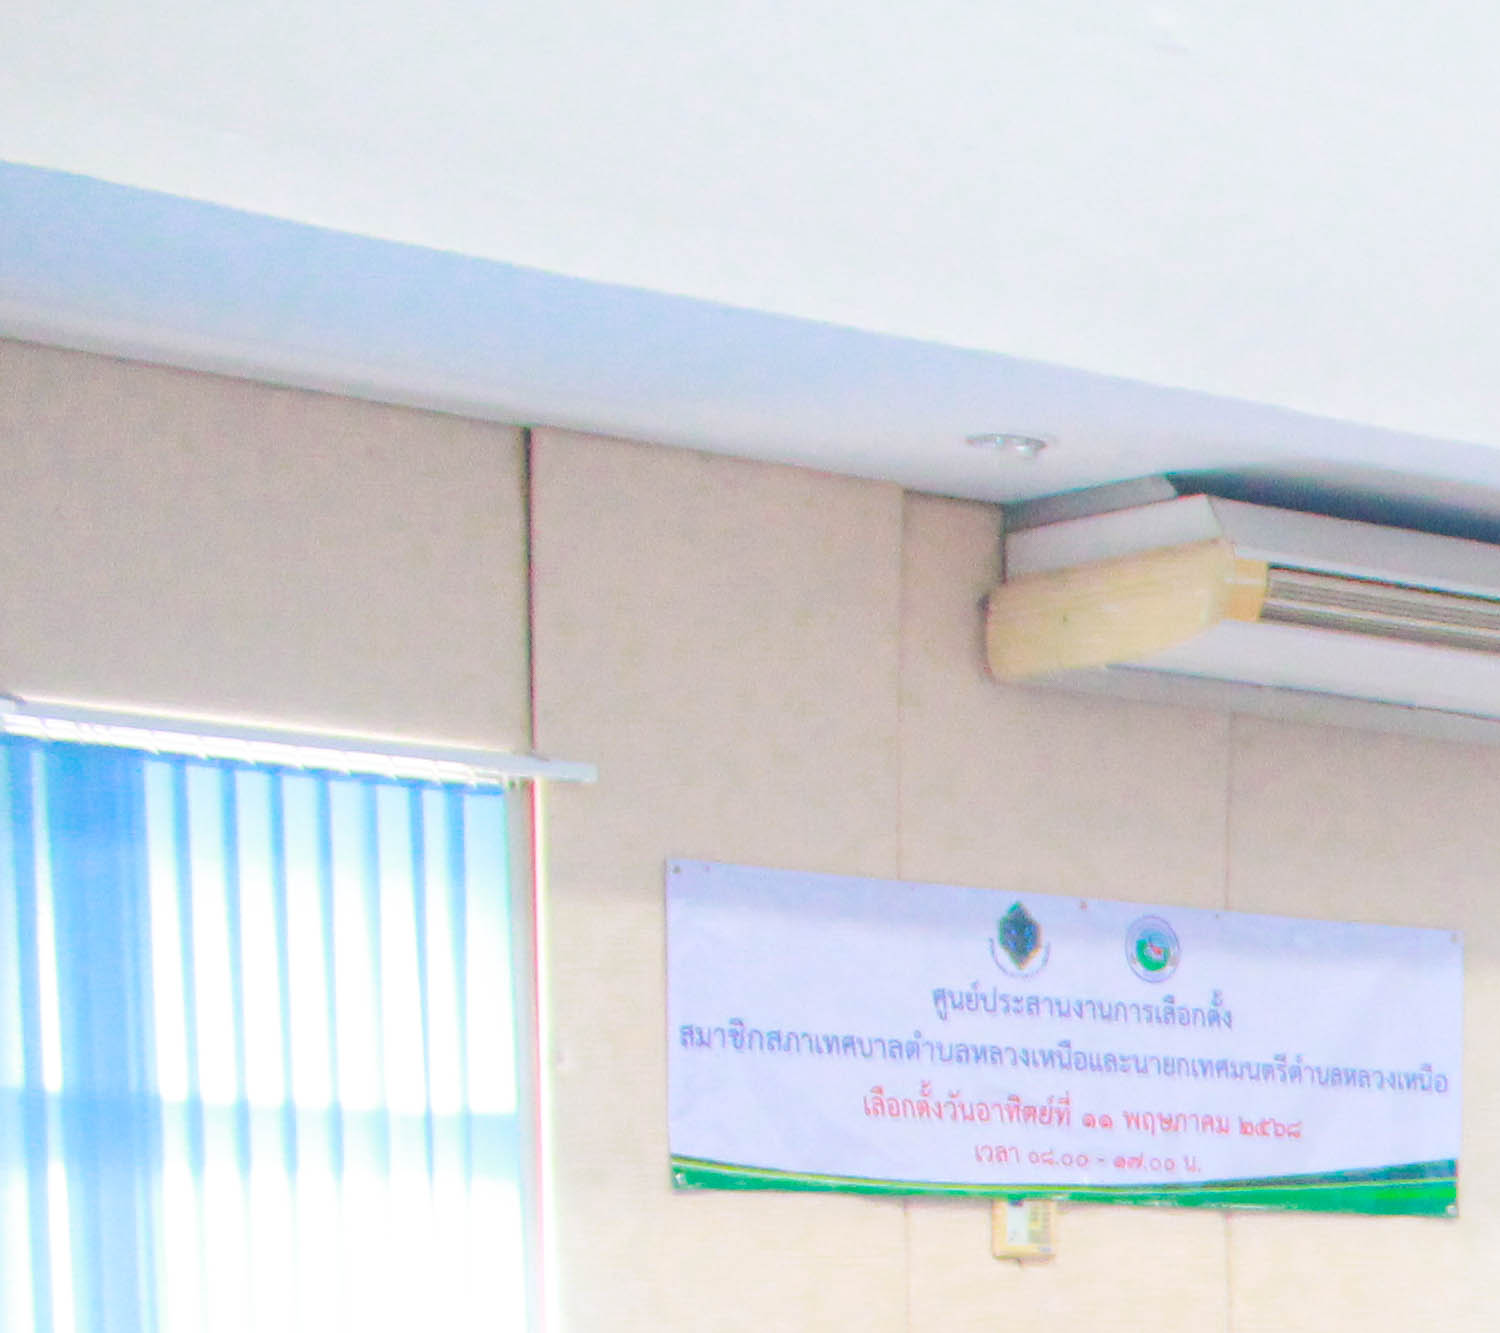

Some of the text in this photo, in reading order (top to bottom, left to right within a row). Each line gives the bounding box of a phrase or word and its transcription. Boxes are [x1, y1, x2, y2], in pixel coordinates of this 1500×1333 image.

[931, 980, 1233, 1030] ศูนย์ประสานงานการเลือกตั้ง
[1122, 1107, 1230, 1135] พฤษภาคม
